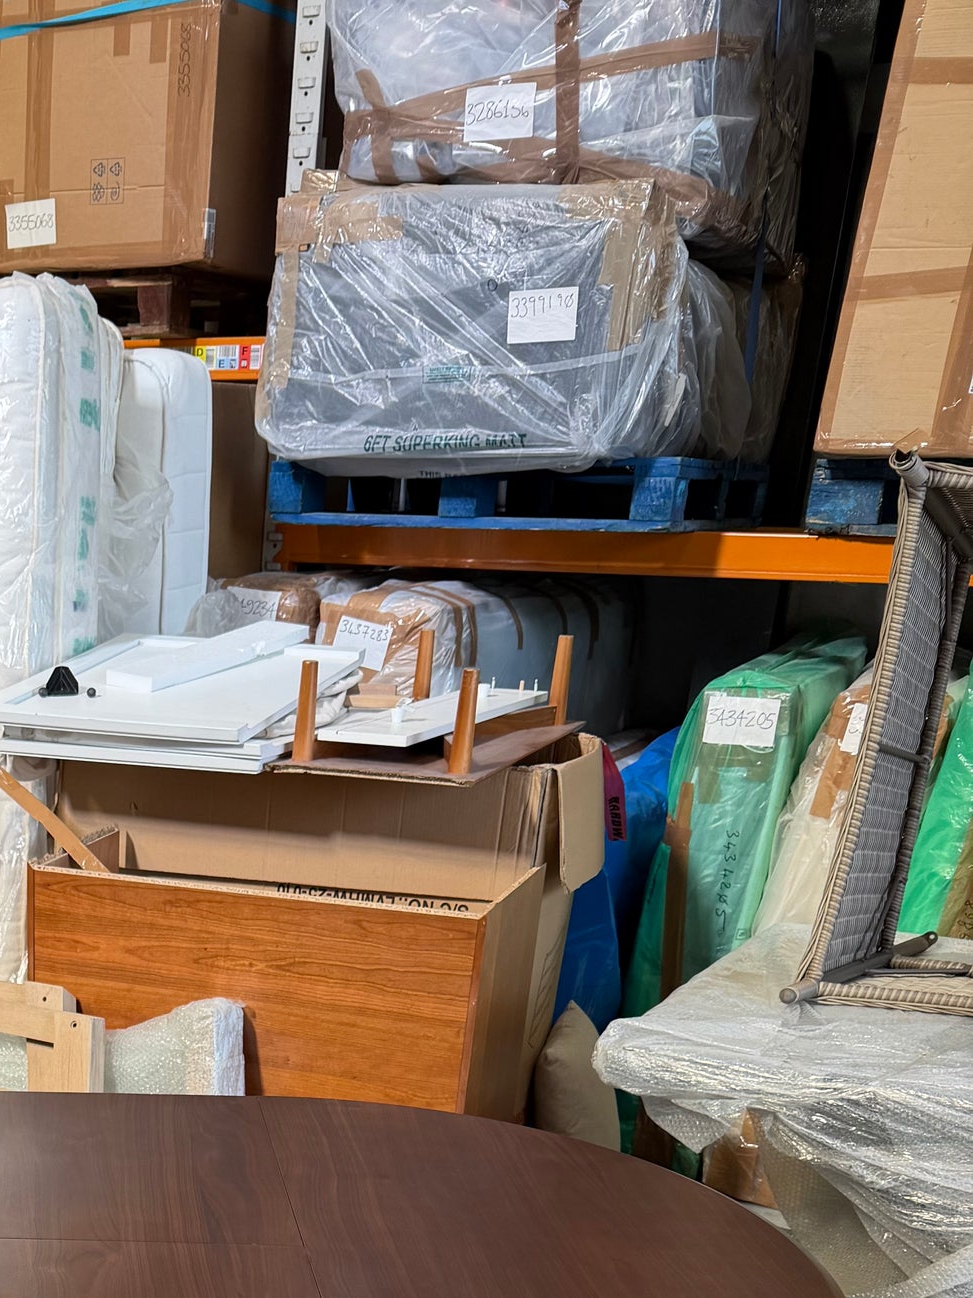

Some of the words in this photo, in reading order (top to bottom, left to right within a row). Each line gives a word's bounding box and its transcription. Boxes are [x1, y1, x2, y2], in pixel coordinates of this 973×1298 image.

[178, 23, 192, 97] 3355068
[466, 99, 530, 126] 3286156
[8, 213, 54, 232] 3355068
[196, 348, 204, 357] D
[242, 346, 248, 355] F
[218, 359, 225, 368] E
[363, 435, 392, 452] 6FT
